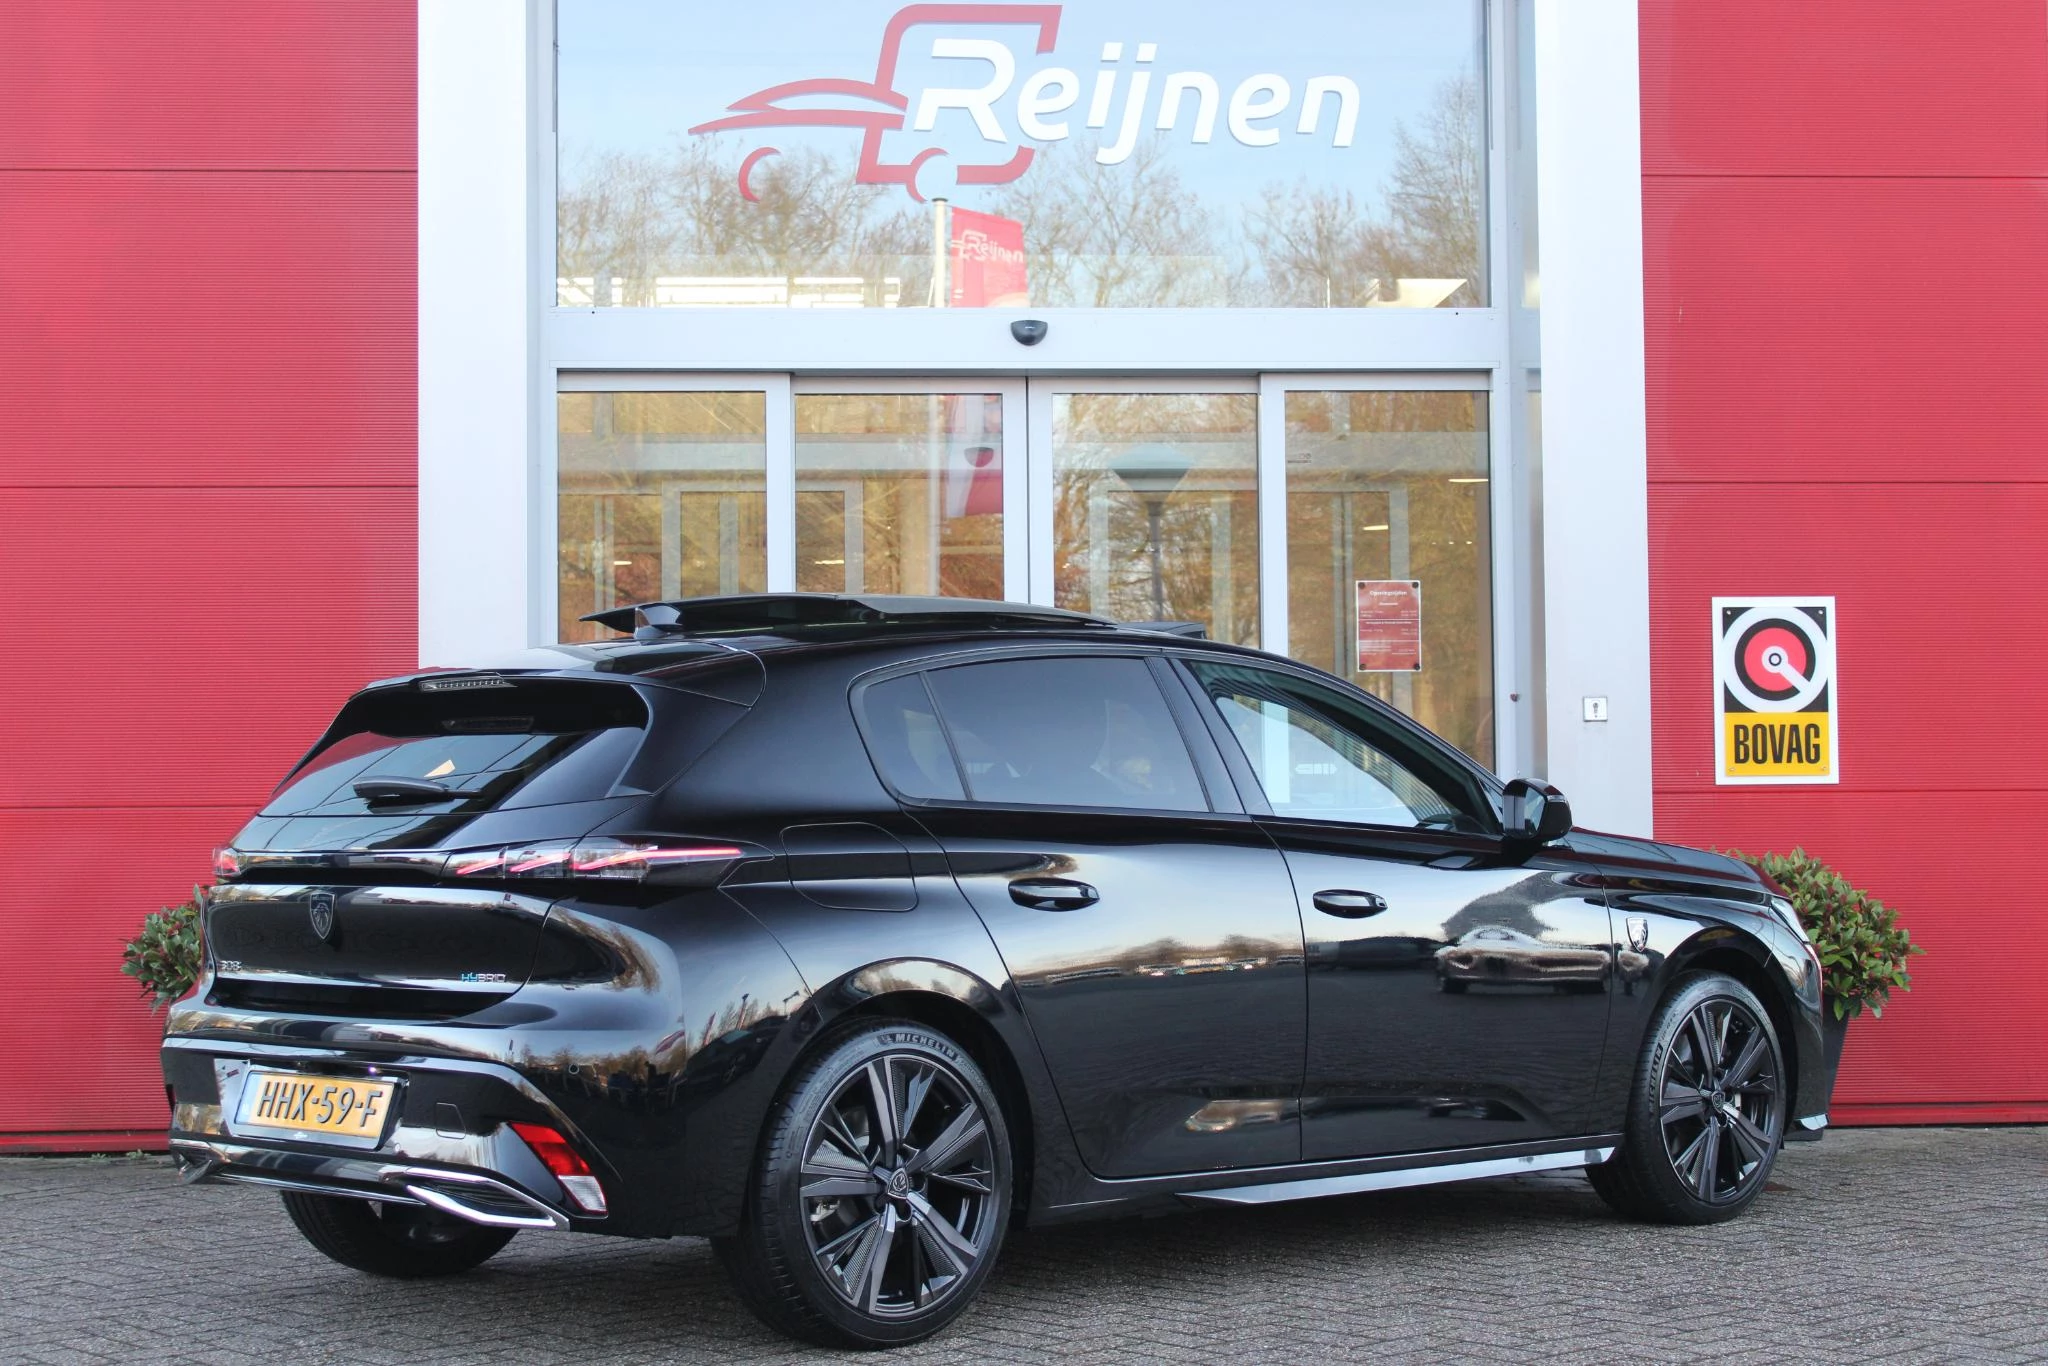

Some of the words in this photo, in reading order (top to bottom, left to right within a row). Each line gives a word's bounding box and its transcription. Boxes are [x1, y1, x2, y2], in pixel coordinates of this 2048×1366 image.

[913, 38, 1360, 166] Reijnen
[1733, 723, 1820, 764] BOVAG
[895, 1033, 955, 1058] MICHELIN
[257, 1081, 383, 1128] HHX-59-F
